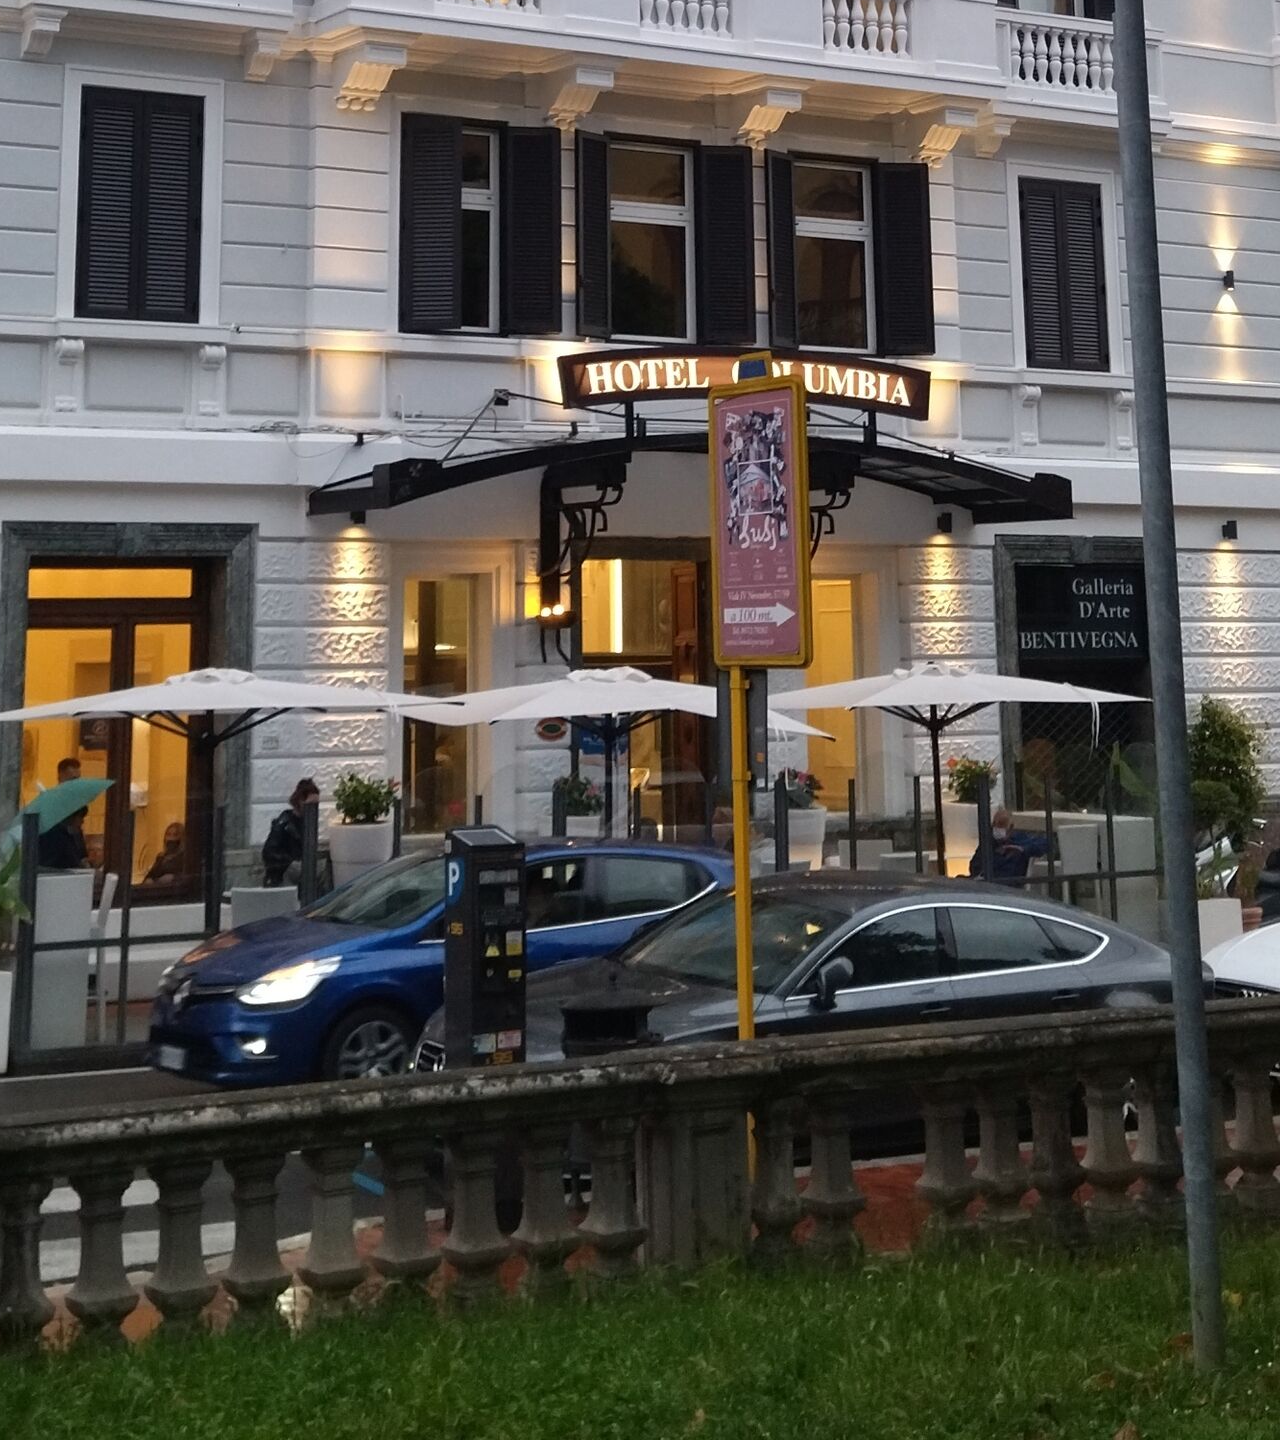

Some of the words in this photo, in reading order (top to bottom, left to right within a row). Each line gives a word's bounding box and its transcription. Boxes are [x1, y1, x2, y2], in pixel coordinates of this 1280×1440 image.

[585, 358, 710, 396] HOTEL
[1072, 578, 1134, 595] Galleria
[739, 608, 757, 622] 100
[1079, 601, 1131, 618] D'Arte
[1020, 631, 1139, 649] BENTIVEGNA
[448, 861, 460, 896] P
